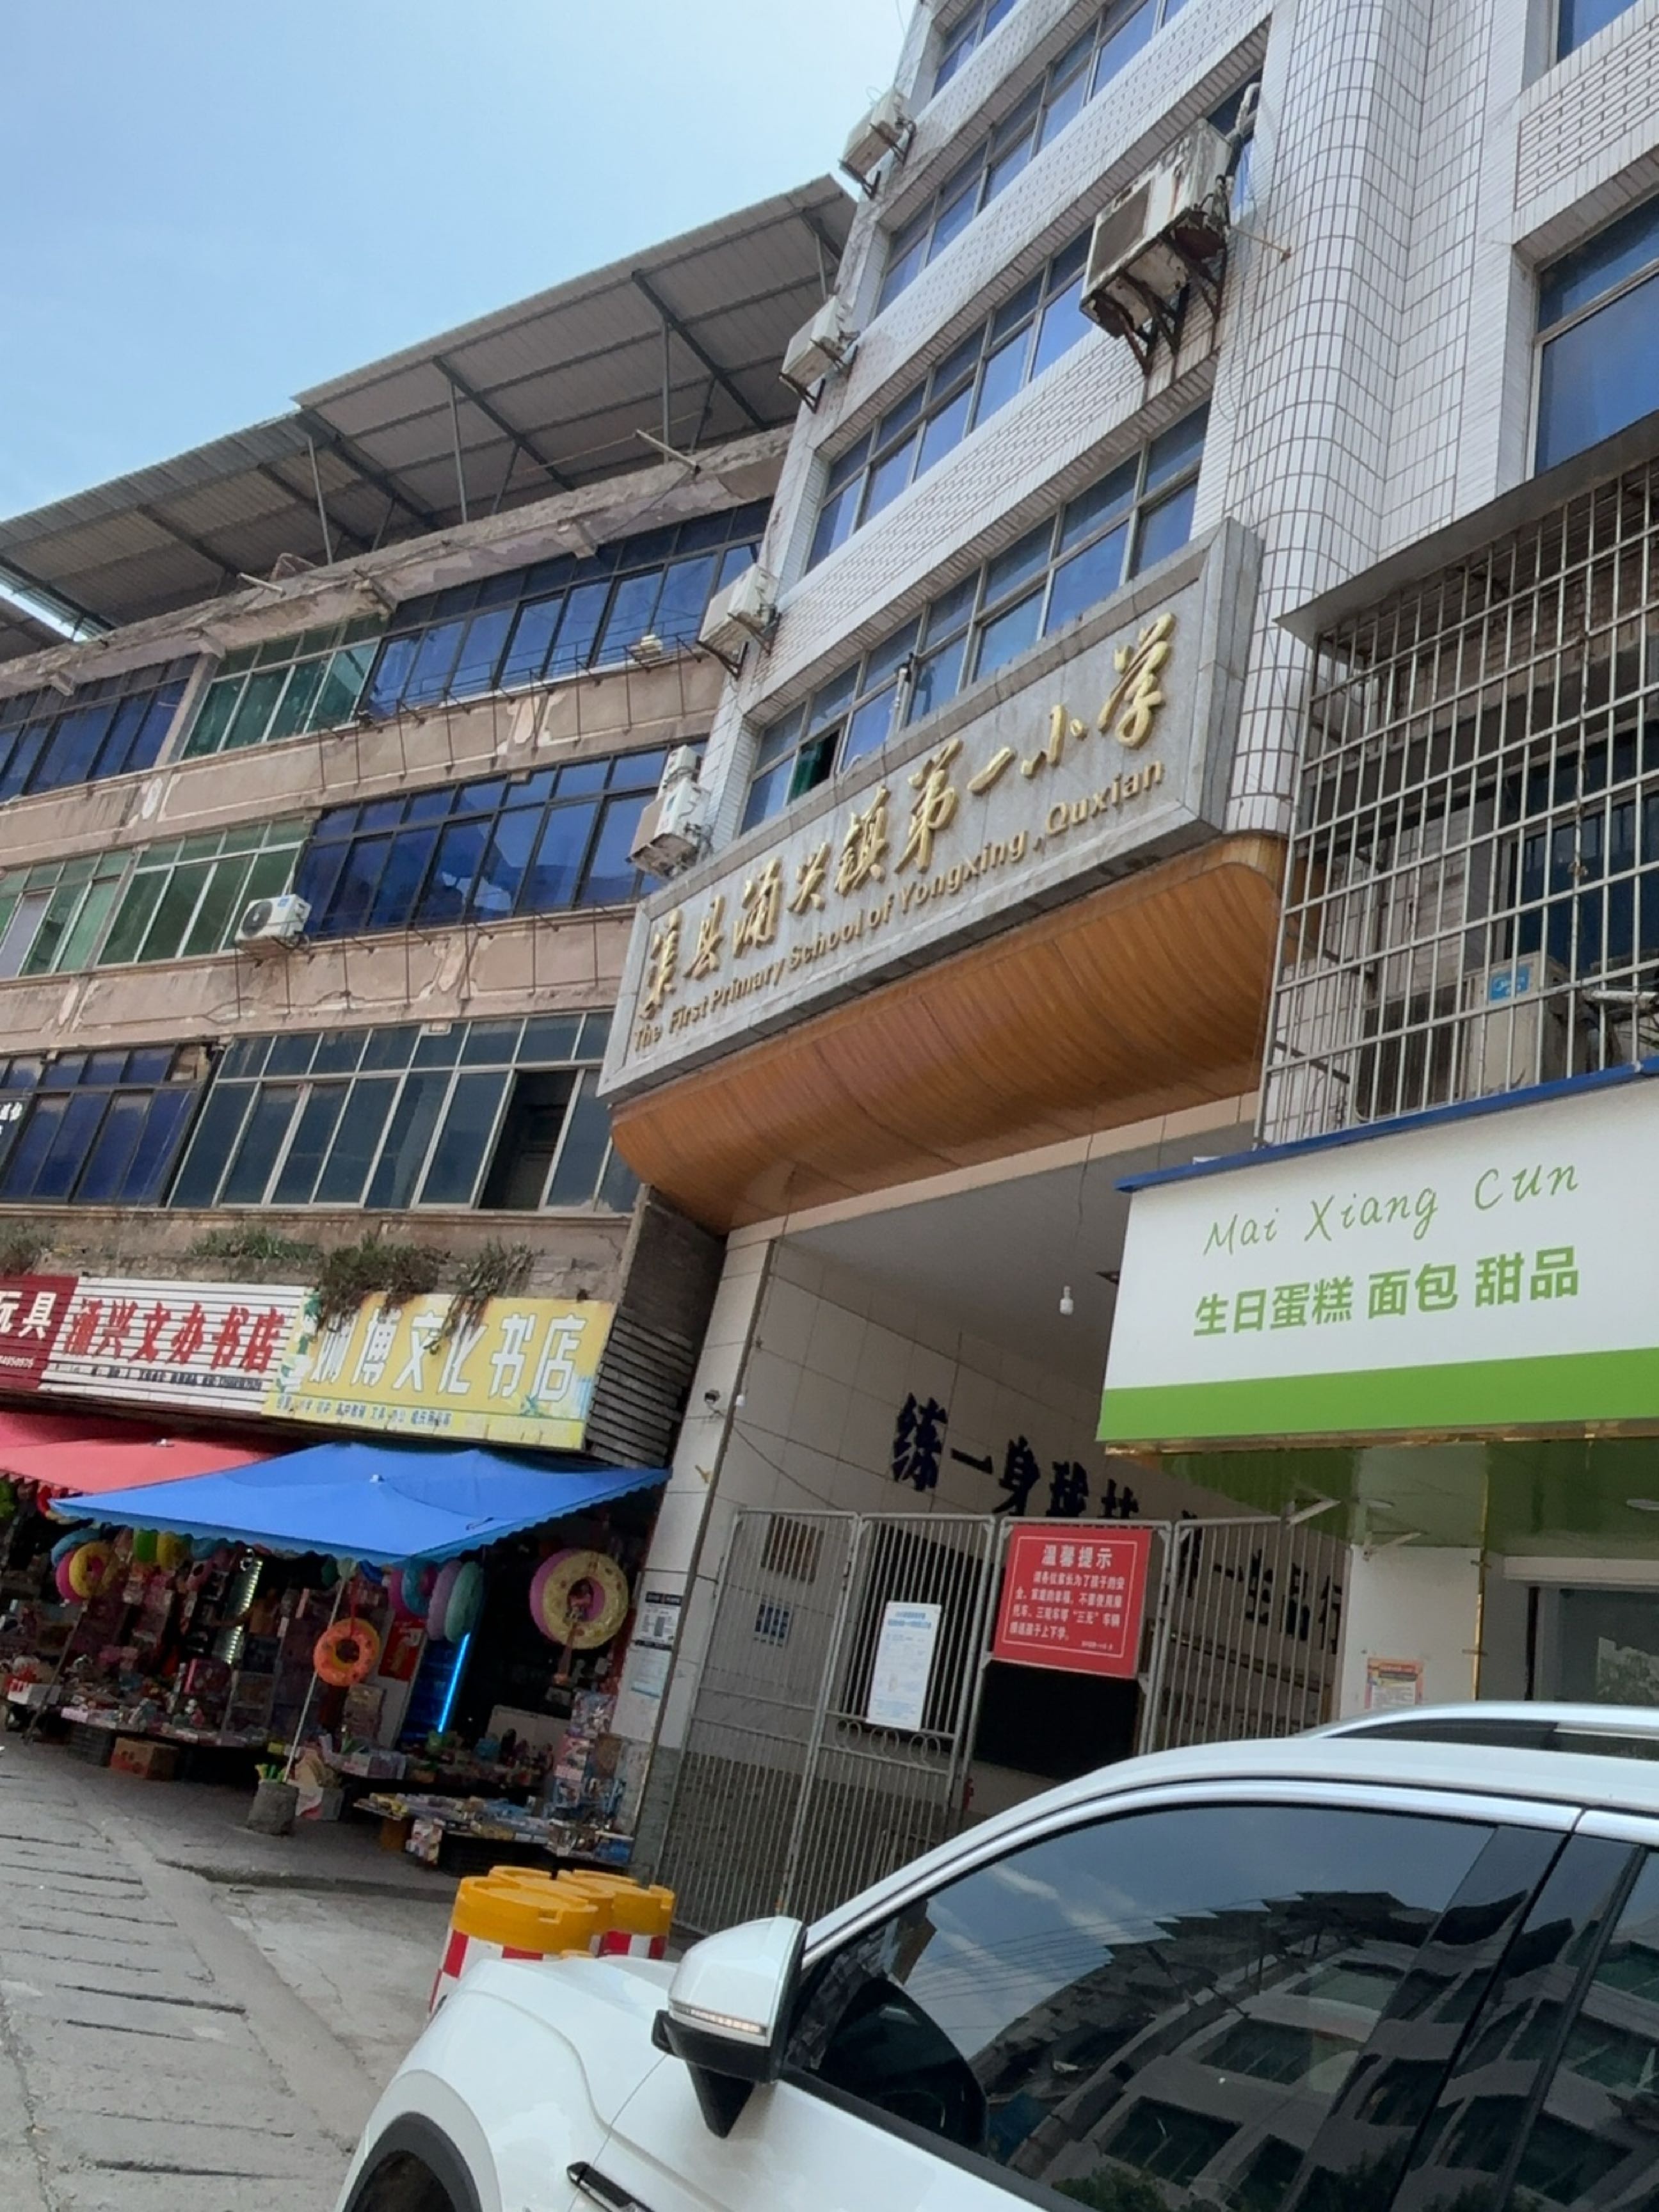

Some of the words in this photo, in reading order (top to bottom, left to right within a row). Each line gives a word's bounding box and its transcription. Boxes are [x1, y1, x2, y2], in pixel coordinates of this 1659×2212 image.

[635, 1024, 661, 1052] The
[669, 996, 709, 1032] First
[711, 958, 785, 1012] Primary
[790, 909, 863, 970] School
[869, 894, 895, 928] of
[1046, 760, 1164, 836] Quxian
[1203, 1207, 1279, 1258] Mai
[1304, 1187, 1438, 1242] Xiang
[1473, 1161, 1580, 1210] Cun
[1192, 1278, 1354, 1337] 生日蛋糕
[1367, 1263, 1459, 1320] 面包
[1473, 1246, 1580, 1308] 甜品
[1041, 1543, 1113, 1570] 温馨提示
